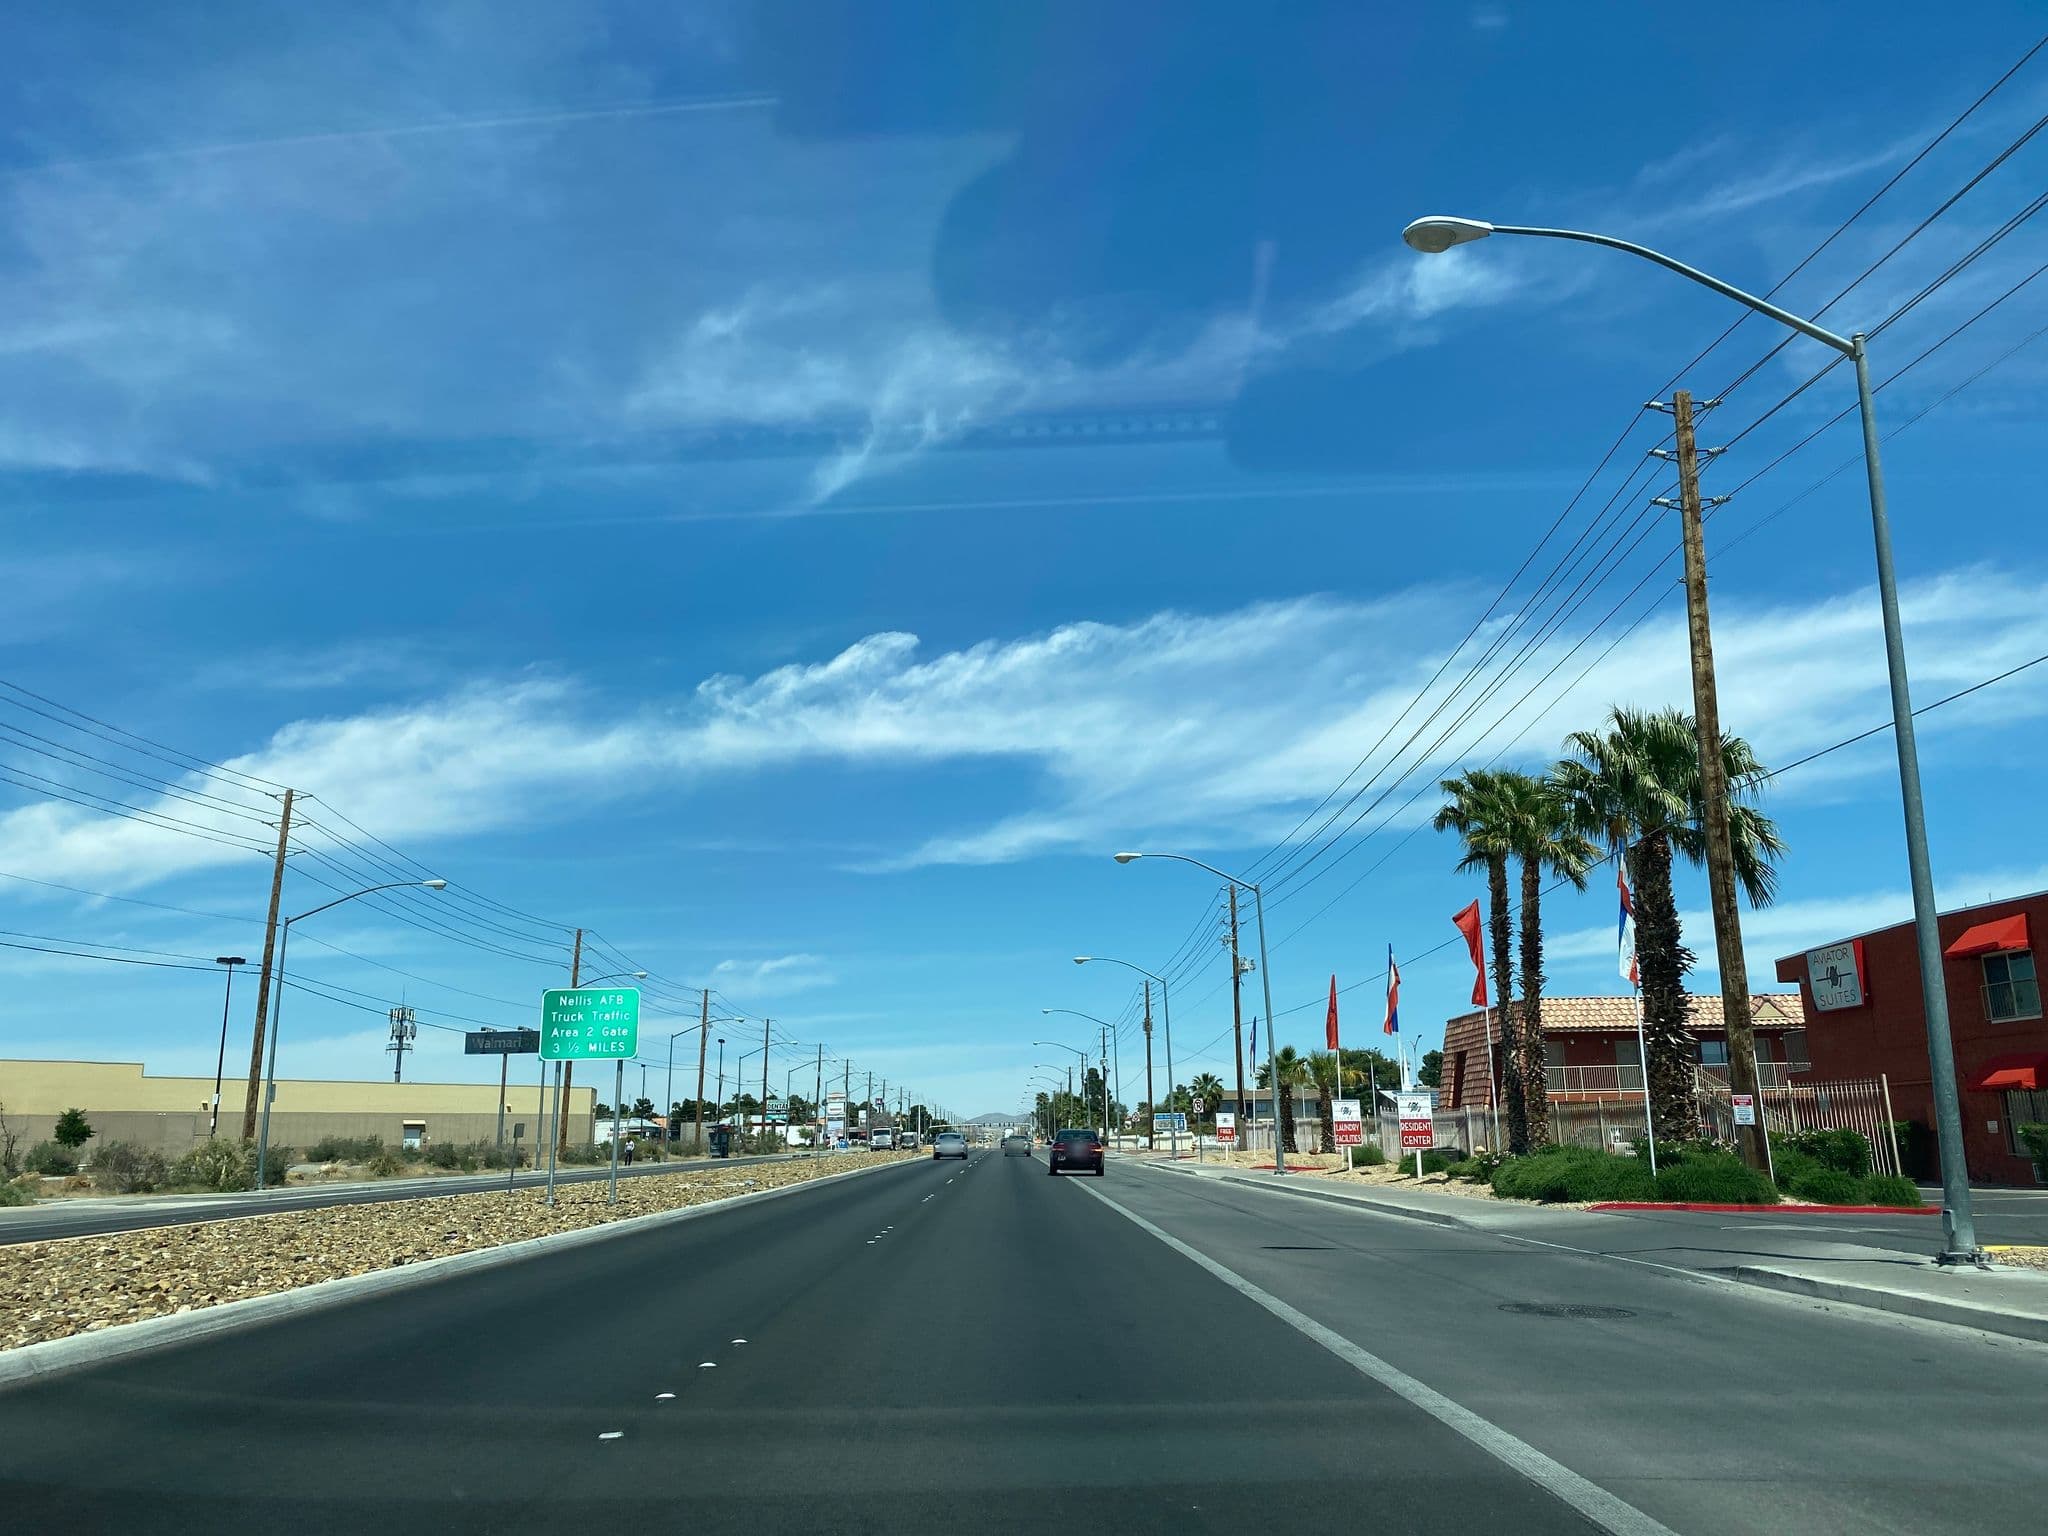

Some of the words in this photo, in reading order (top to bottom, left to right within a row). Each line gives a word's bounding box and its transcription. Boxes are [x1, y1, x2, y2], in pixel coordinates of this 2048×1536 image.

[1814, 947, 1849, 965] AVIATOR
[559, 995, 592, 1006] Nellis
[599, 995, 624, 1005] AFB
[1819, 989, 1856, 1007] SUITES
[551, 1011, 584, 1022] Truck
[592, 1010, 631, 1021] Traffic
[551, 1027, 579, 1038] Area
[586, 1026, 593, 1037] 2
[602, 1026, 628, 1037] Gate
[472, 1036, 522, 1049] Walmart
[552, 1043, 560, 1054] 3
[588, 1041, 625, 1052] MILES
[1335, 1123, 1360, 1132] LAUNDRY
[1400, 1122, 1431, 1131] RESIDENT
[1336, 1135, 1361, 1143] FACILITIES
[1403, 1135, 1431, 1145] CENTER
